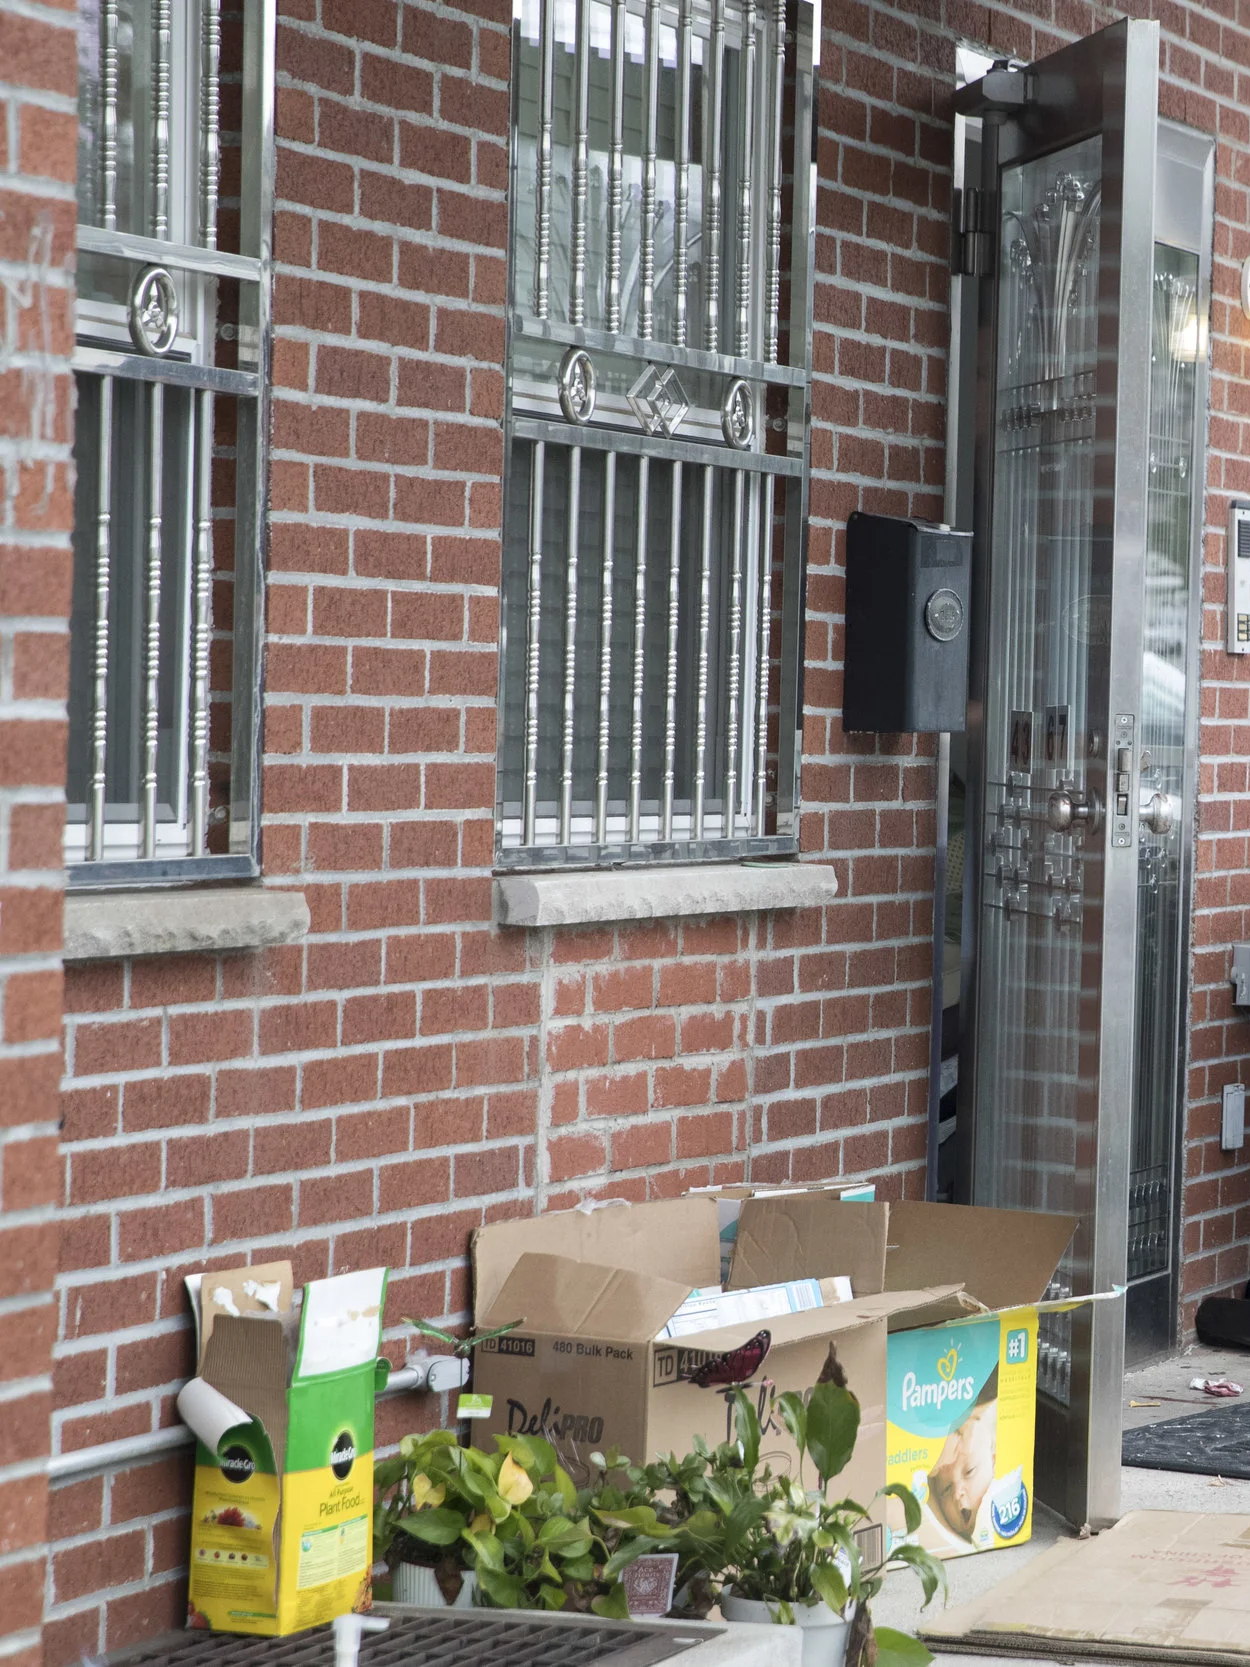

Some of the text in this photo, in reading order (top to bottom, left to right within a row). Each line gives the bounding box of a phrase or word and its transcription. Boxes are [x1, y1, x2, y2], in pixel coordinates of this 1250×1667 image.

[1011, 714, 1067, 765] 43 67
[500, 1339, 533, 1353] 41016
[552, 1341, 634, 1360] 480 Bulk Pack
[1008, 1332, 1026, 1359] #1
[657, 1355, 674, 1377] TD
[902, 1371, 975, 1411] Pampers
[888, 1447, 929, 1466] addlers
[319, 1493, 361, 1518] Plant Food
[999, 1498, 1020, 1525] 216
